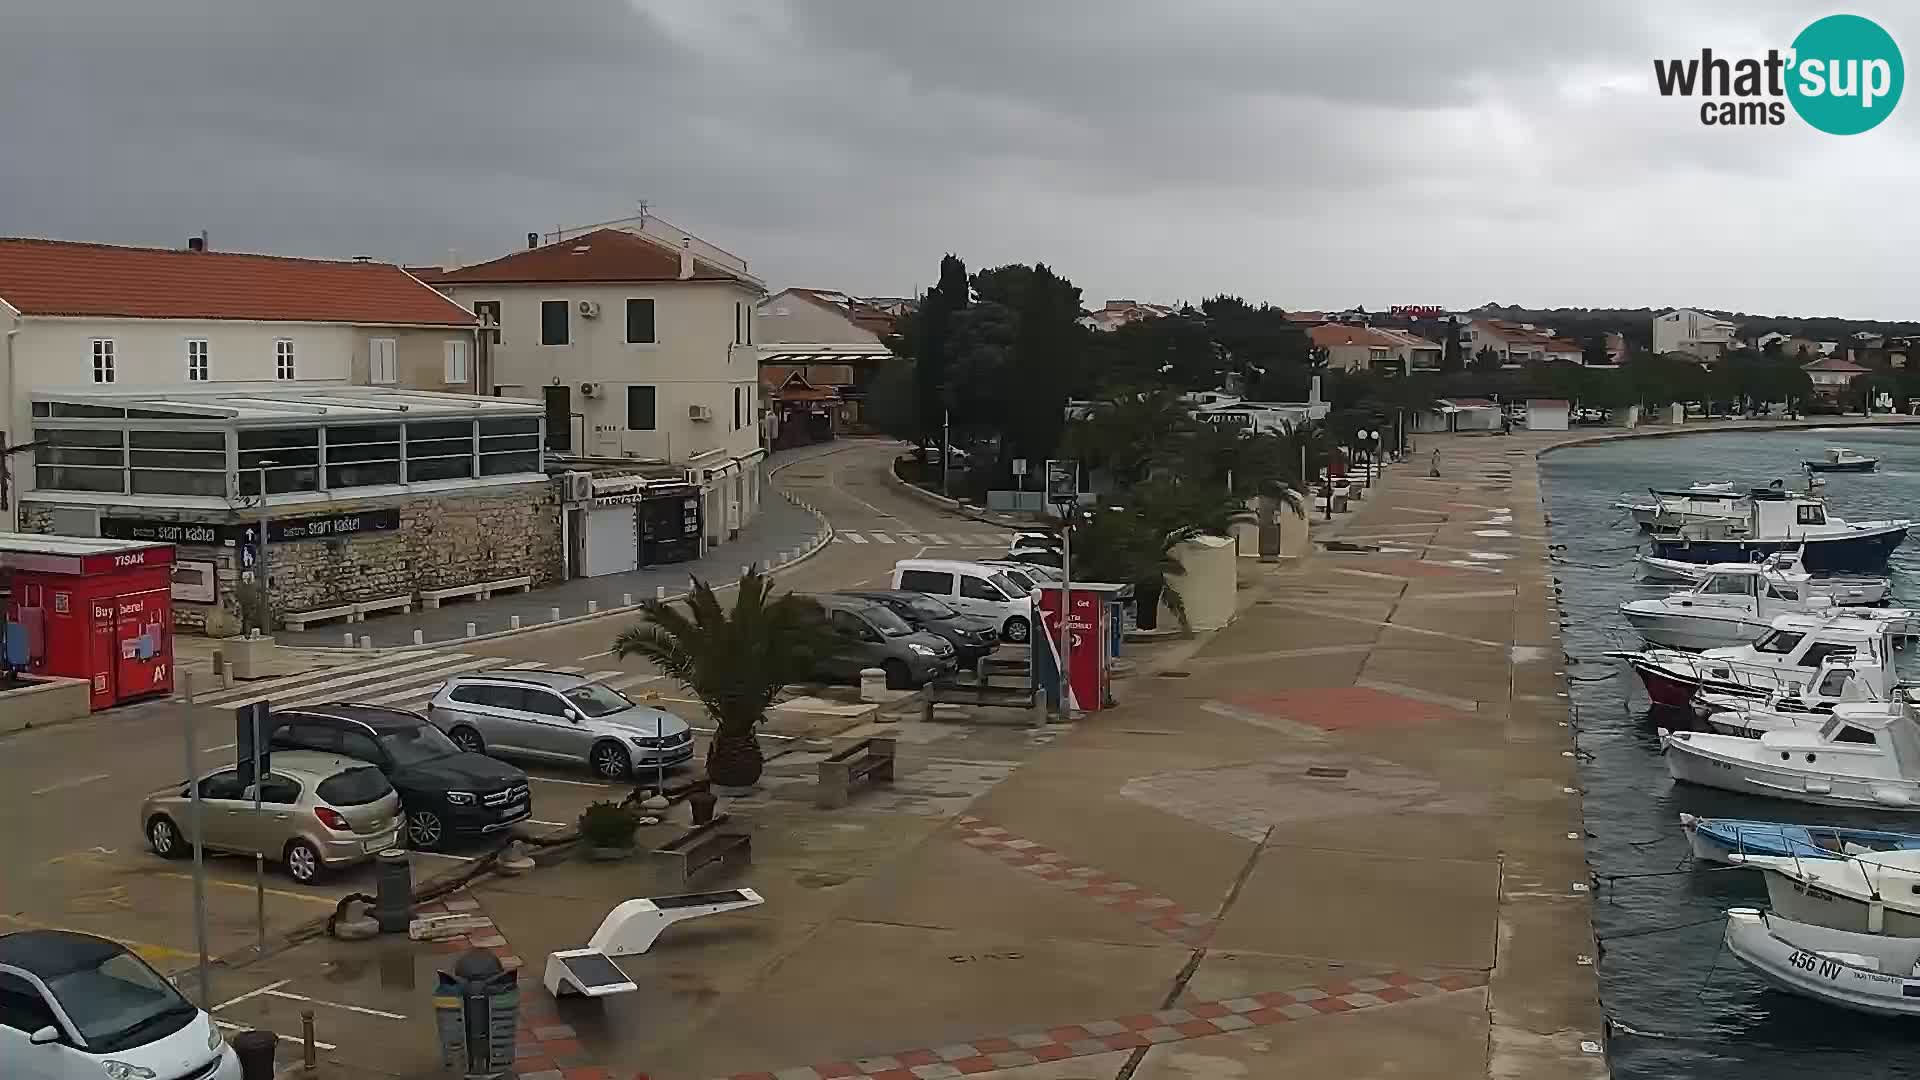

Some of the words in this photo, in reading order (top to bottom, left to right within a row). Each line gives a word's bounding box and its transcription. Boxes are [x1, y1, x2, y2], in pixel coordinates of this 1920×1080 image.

[114, 553, 145, 566] TISAK
[95, 606, 114, 619] Buy
[153, 664, 166, 683] A1
[1788, 951, 1816, 972] 456
[1819, 960, 1842, 980] NV
